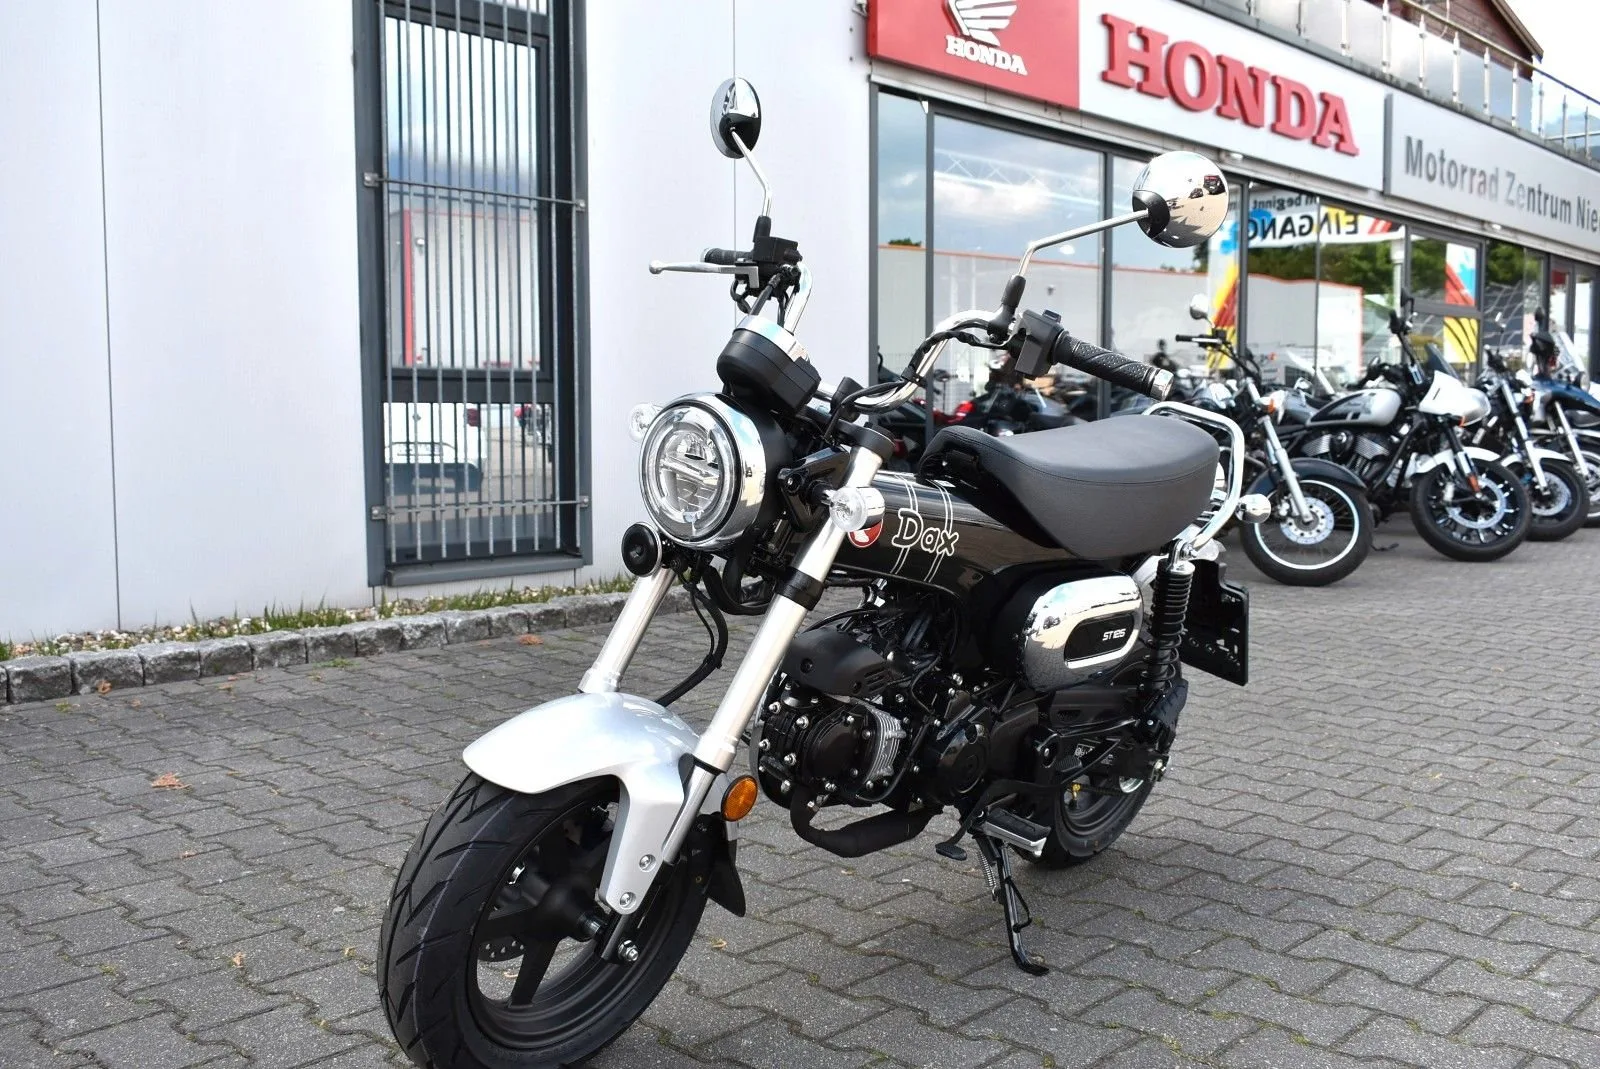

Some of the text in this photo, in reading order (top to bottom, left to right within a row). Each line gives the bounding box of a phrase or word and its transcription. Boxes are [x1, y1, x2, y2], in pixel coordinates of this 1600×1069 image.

[945, 34, 1028, 76] HONDA
[1099, 13, 1359, 156] HONDA
[1405, 135, 1600, 233] Motorrad Zentrum Nie
[892, 507, 960, 557] Dax
[1102, 628, 1127, 641] ST125
